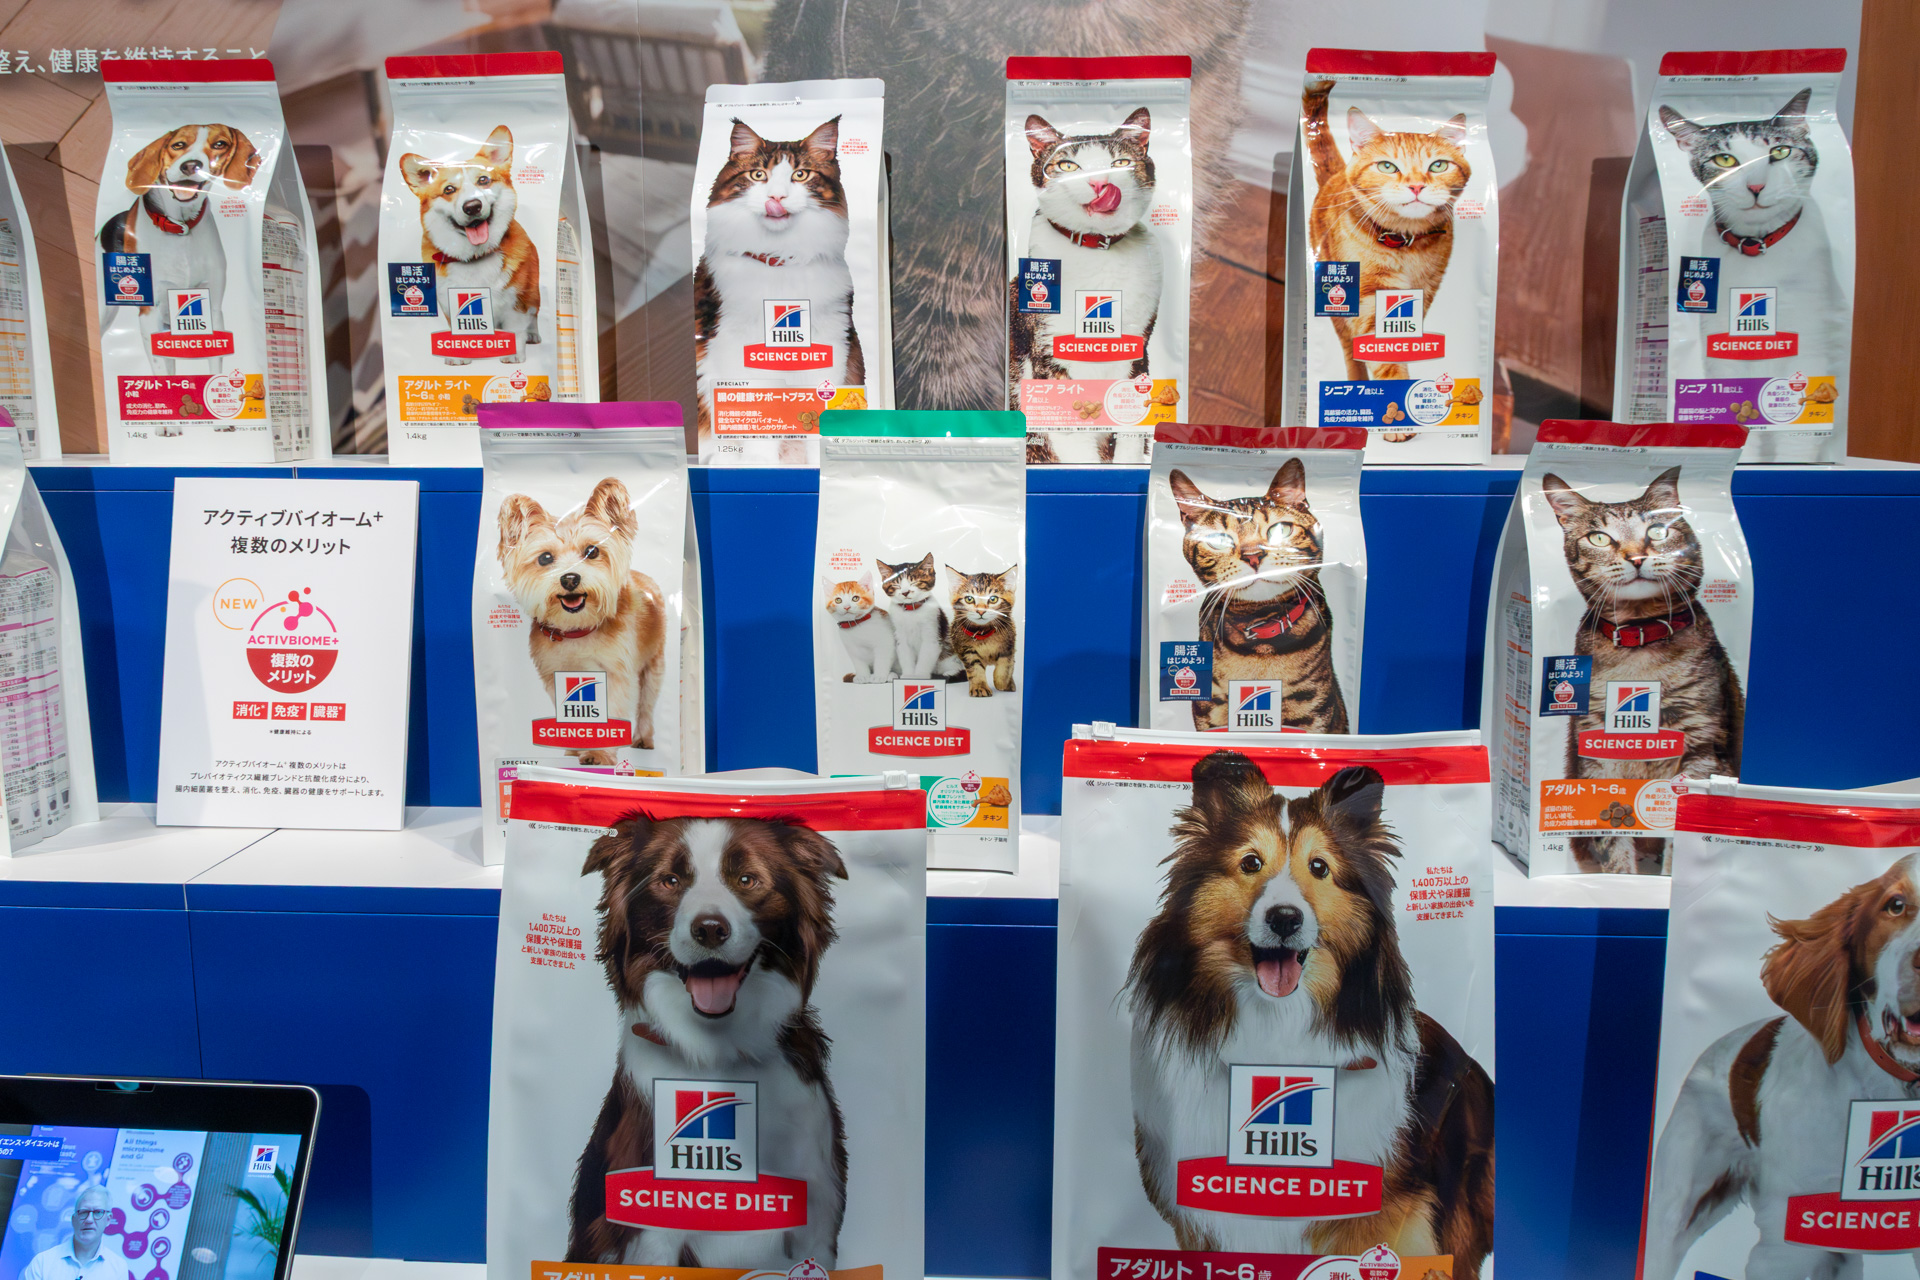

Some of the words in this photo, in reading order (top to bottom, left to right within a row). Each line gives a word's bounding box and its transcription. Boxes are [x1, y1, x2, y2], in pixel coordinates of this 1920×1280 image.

[1024, 272, 1055, 280] はじめよう!
[1321, 275, 1353, 283] はじめよう!
[177, 318, 207, 331] Hill's
[457, 318, 488, 330] Hill's
[1082, 321, 1115, 333] Hill's
[1383, 320, 1416, 333] Hill's
[1737, 318, 1769, 331] Hill's
[772, 330, 804, 342] Hill's
[157, 339, 203, 349] SCIENCE
[204, 339, 229, 348] DIET
[437, 339, 484, 349] SCIENCE
[486, 339, 511, 348] DIET
[1059, 343, 1108, 352] SCIENCE
[1111, 343, 1138, 352] DIET
[1359, 343, 1408, 353] SCIENCE
[1412, 342, 1439, 352] DIET
[1712, 341, 1762, 351] SCIENCE
[1765, 340, 1792, 350] DIET
[750, 352, 798, 361] SCIENCE
[801, 352, 827, 361] DIET
[123, 380, 163, 390] アダルト
[404, 380, 442, 390] アダルト
[444, 380, 472, 390] ライト
[1025, 384, 1053, 394] シニア
[1056, 384, 1085, 394] ライト
[1324, 385, 1353, 396] シニア
[1356, 385, 1384, 395] 7歳以上
[1679, 383, 1707, 394] シニア
[717, 392, 815, 402] 腸の健康サポートプラス
[1026, 394, 1049, 404] 7歳以上
[406, 432, 427, 440] 1.4kg
[717, 445, 743, 453] 1.25kg
[230, 536, 351, 555] 複数のメリット
[220, 598, 258, 610] NEW
[247, 635, 339, 646] ACTIVBIOME+
[1174, 644, 1198, 656] 腸活
[270, 653, 314, 667] 複数の
[1167, 656, 1205, 665] はじめよう!
[267, 670, 316, 685] メリット
[1548, 671, 1584, 679] はじめよう!
[563, 704, 600, 718] Hill's
[901, 712, 938, 726] Hill's
[1236, 713, 1274, 727] Hill's
[1613, 715, 1651, 728] Hill's
[538, 727, 593, 738] SCIENCE
[596, 728, 626, 738] DIET
[875, 736, 931, 747] SCIENCE
[933, 736, 964, 747] DIET
[1585, 739, 1642, 749] SCIENCE
[1646, 739, 1677, 749] DIET
[288, 761, 346, 770] 複数のメリットは
[1545, 784, 1586, 796] アダルト
[1542, 844, 1564, 852] 1.4kg
[1426, 866, 1453, 875] 私たちは
[1411, 876, 1469, 888] 1,400万以上の
[1409, 887, 1471, 901] 保護犬や保護猫
[1405, 900, 1475, 911] と新しい家族の出会いを
[542, 913, 567, 923] 私たちは
[1416, 910, 1464, 921] 支援してきました
[528, 922, 581, 937] 1,400万以上の
[525, 933, 583, 950] 保護犬や保護猫
[521, 945, 587, 961] と新しい家族の出会いを
[530, 956, 576, 970] 支援してきました
[1244, 1130, 1318, 1157] Hill's
[670, 1144, 743, 1171] Hill's
[253, 1162, 272, 1171] Hill's
[1191, 1175, 1301, 1195] SCIENCE
[1309, 1178, 1369, 1198] DIET
[619, 1188, 728, 1210] SCIENCE
[735, 1193, 794, 1212] DIET
[1800, 1211, 1912, 1229] SCIENCE
[1110, 1258, 1193, 1280] アダルト
